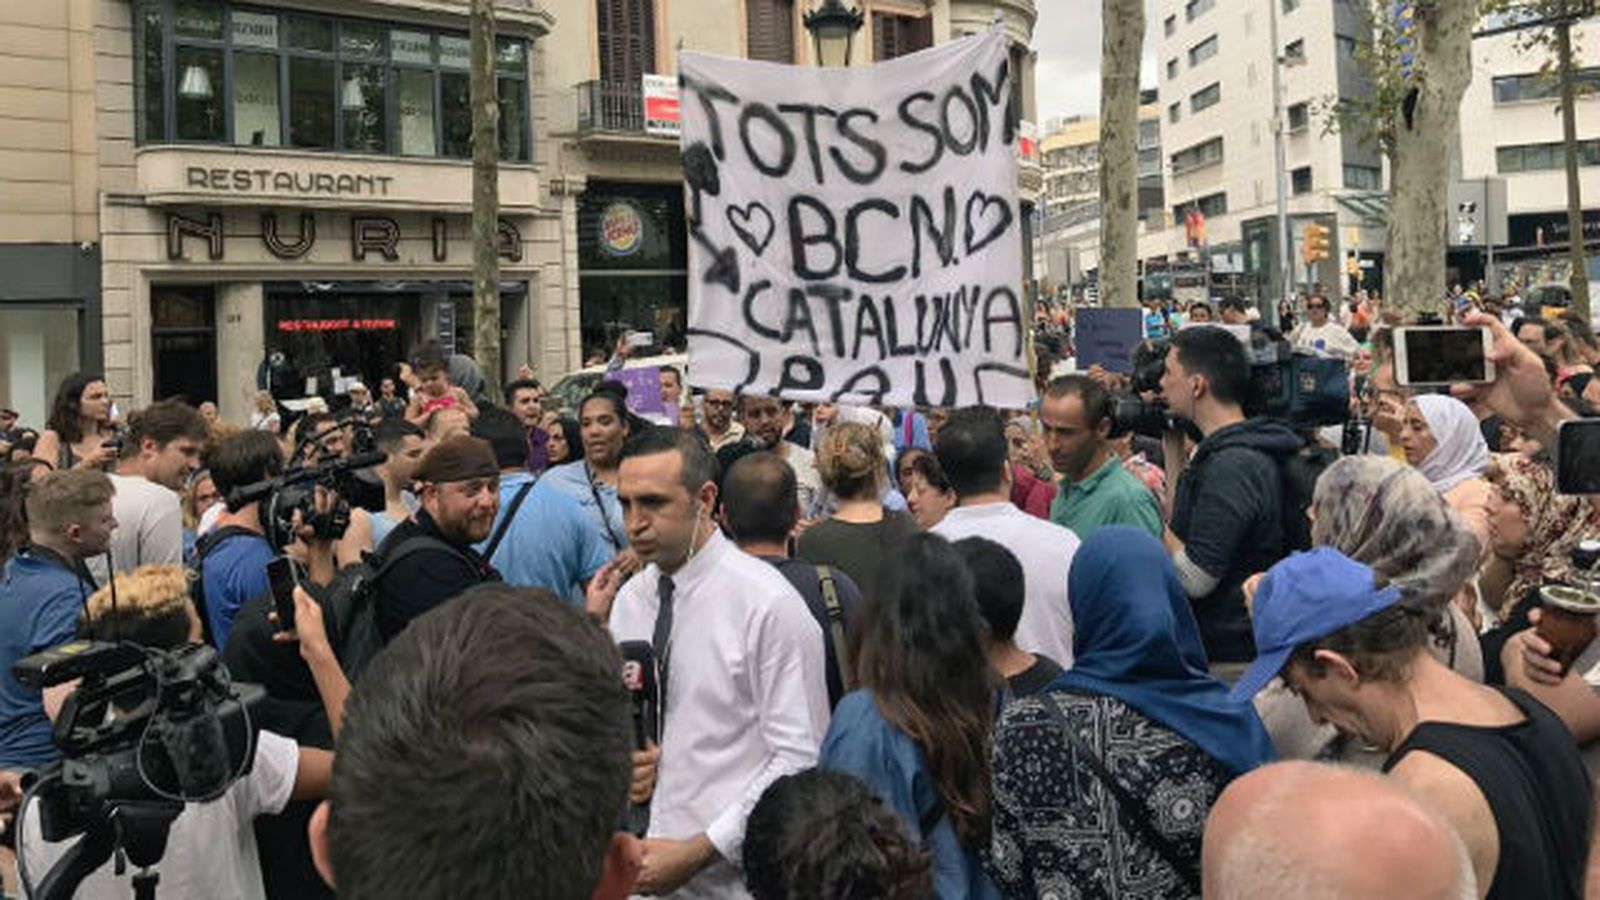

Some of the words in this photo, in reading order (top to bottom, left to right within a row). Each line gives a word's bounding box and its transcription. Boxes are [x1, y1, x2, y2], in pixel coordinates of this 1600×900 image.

[680, 74, 887, 184] TOTS
[898, 60, 1014, 174] SOM
[187, 167, 394, 195] RESTAURANT
[742, 280, 1023, 360] CATALUNYA
[769, 355, 958, 406] PAU
